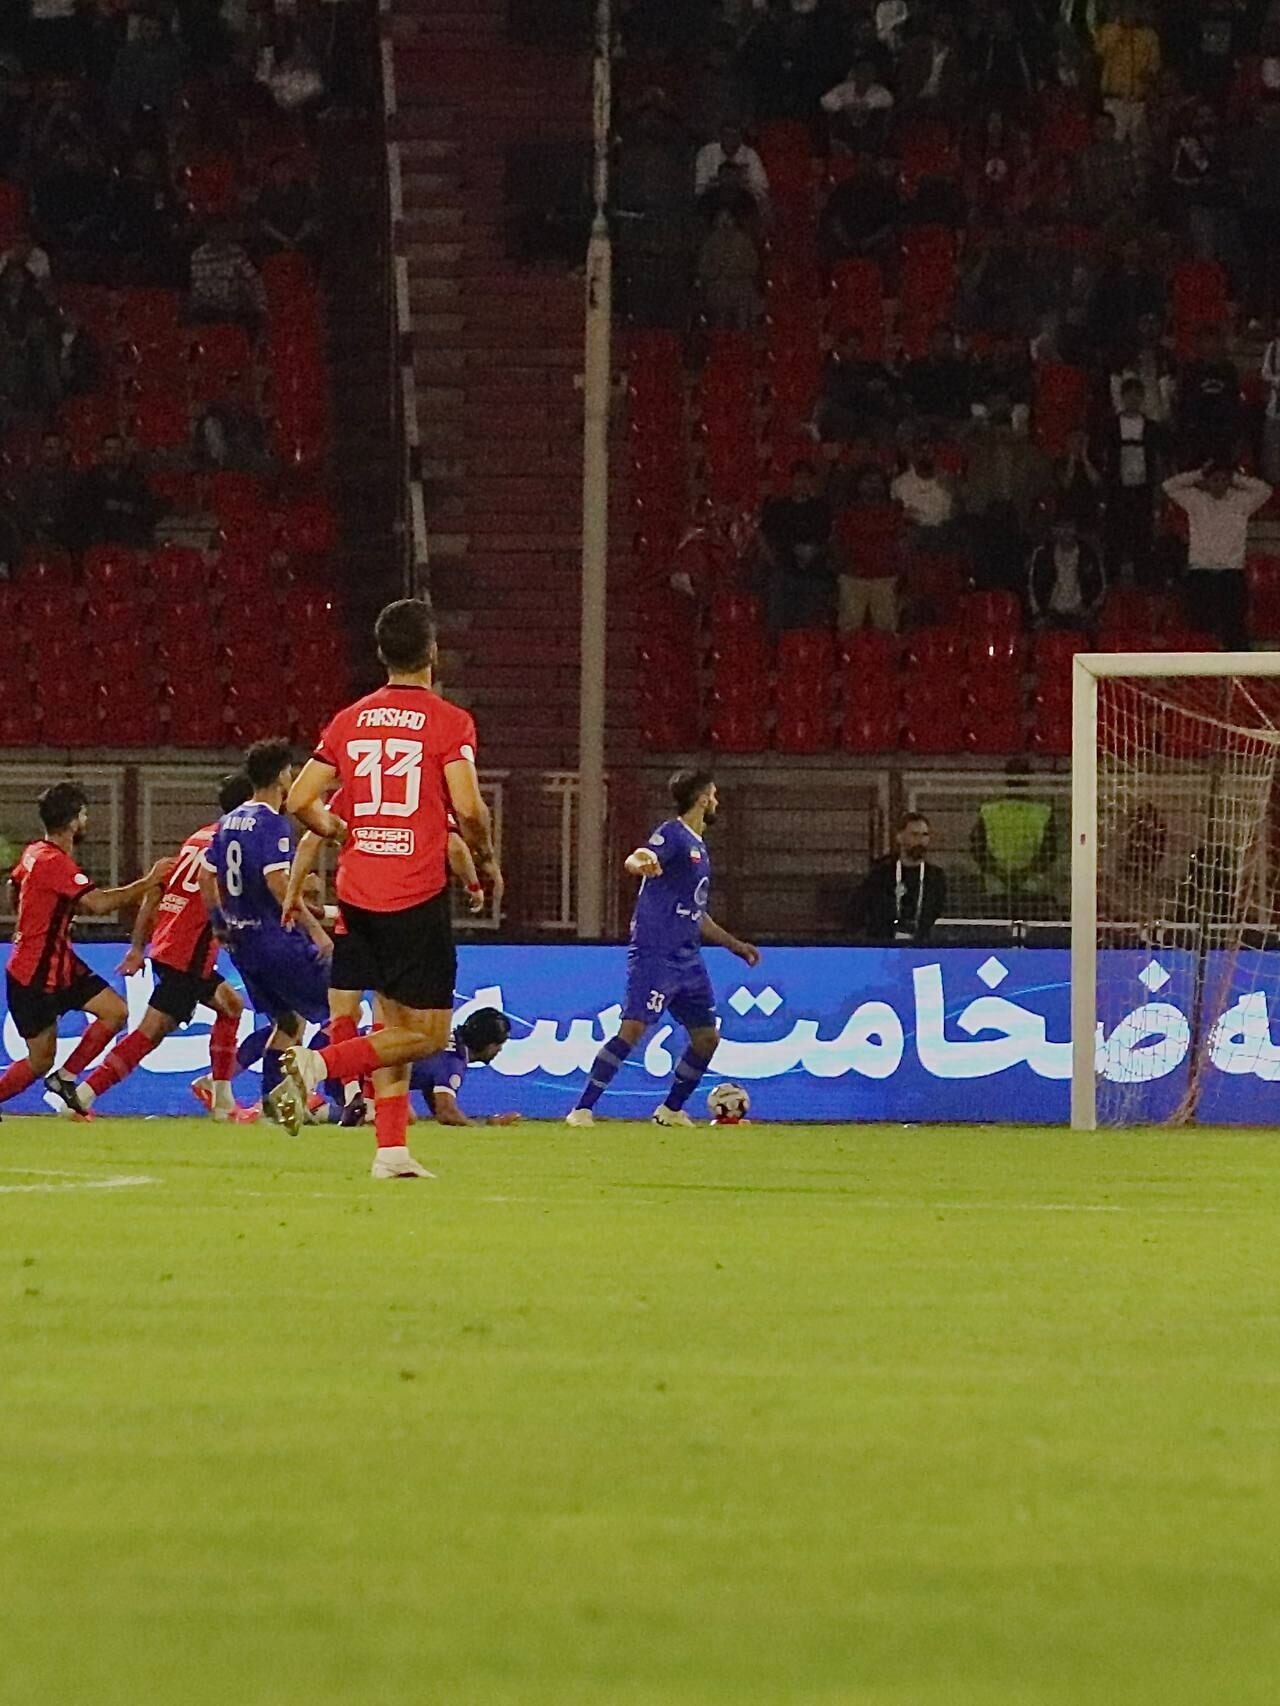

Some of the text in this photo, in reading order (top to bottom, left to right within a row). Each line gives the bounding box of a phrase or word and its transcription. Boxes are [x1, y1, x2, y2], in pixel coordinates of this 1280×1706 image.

[356, 708, 426, 731] FARSHAD
[346, 738, 423, 818] 33
[226, 840, 243, 896] 8
